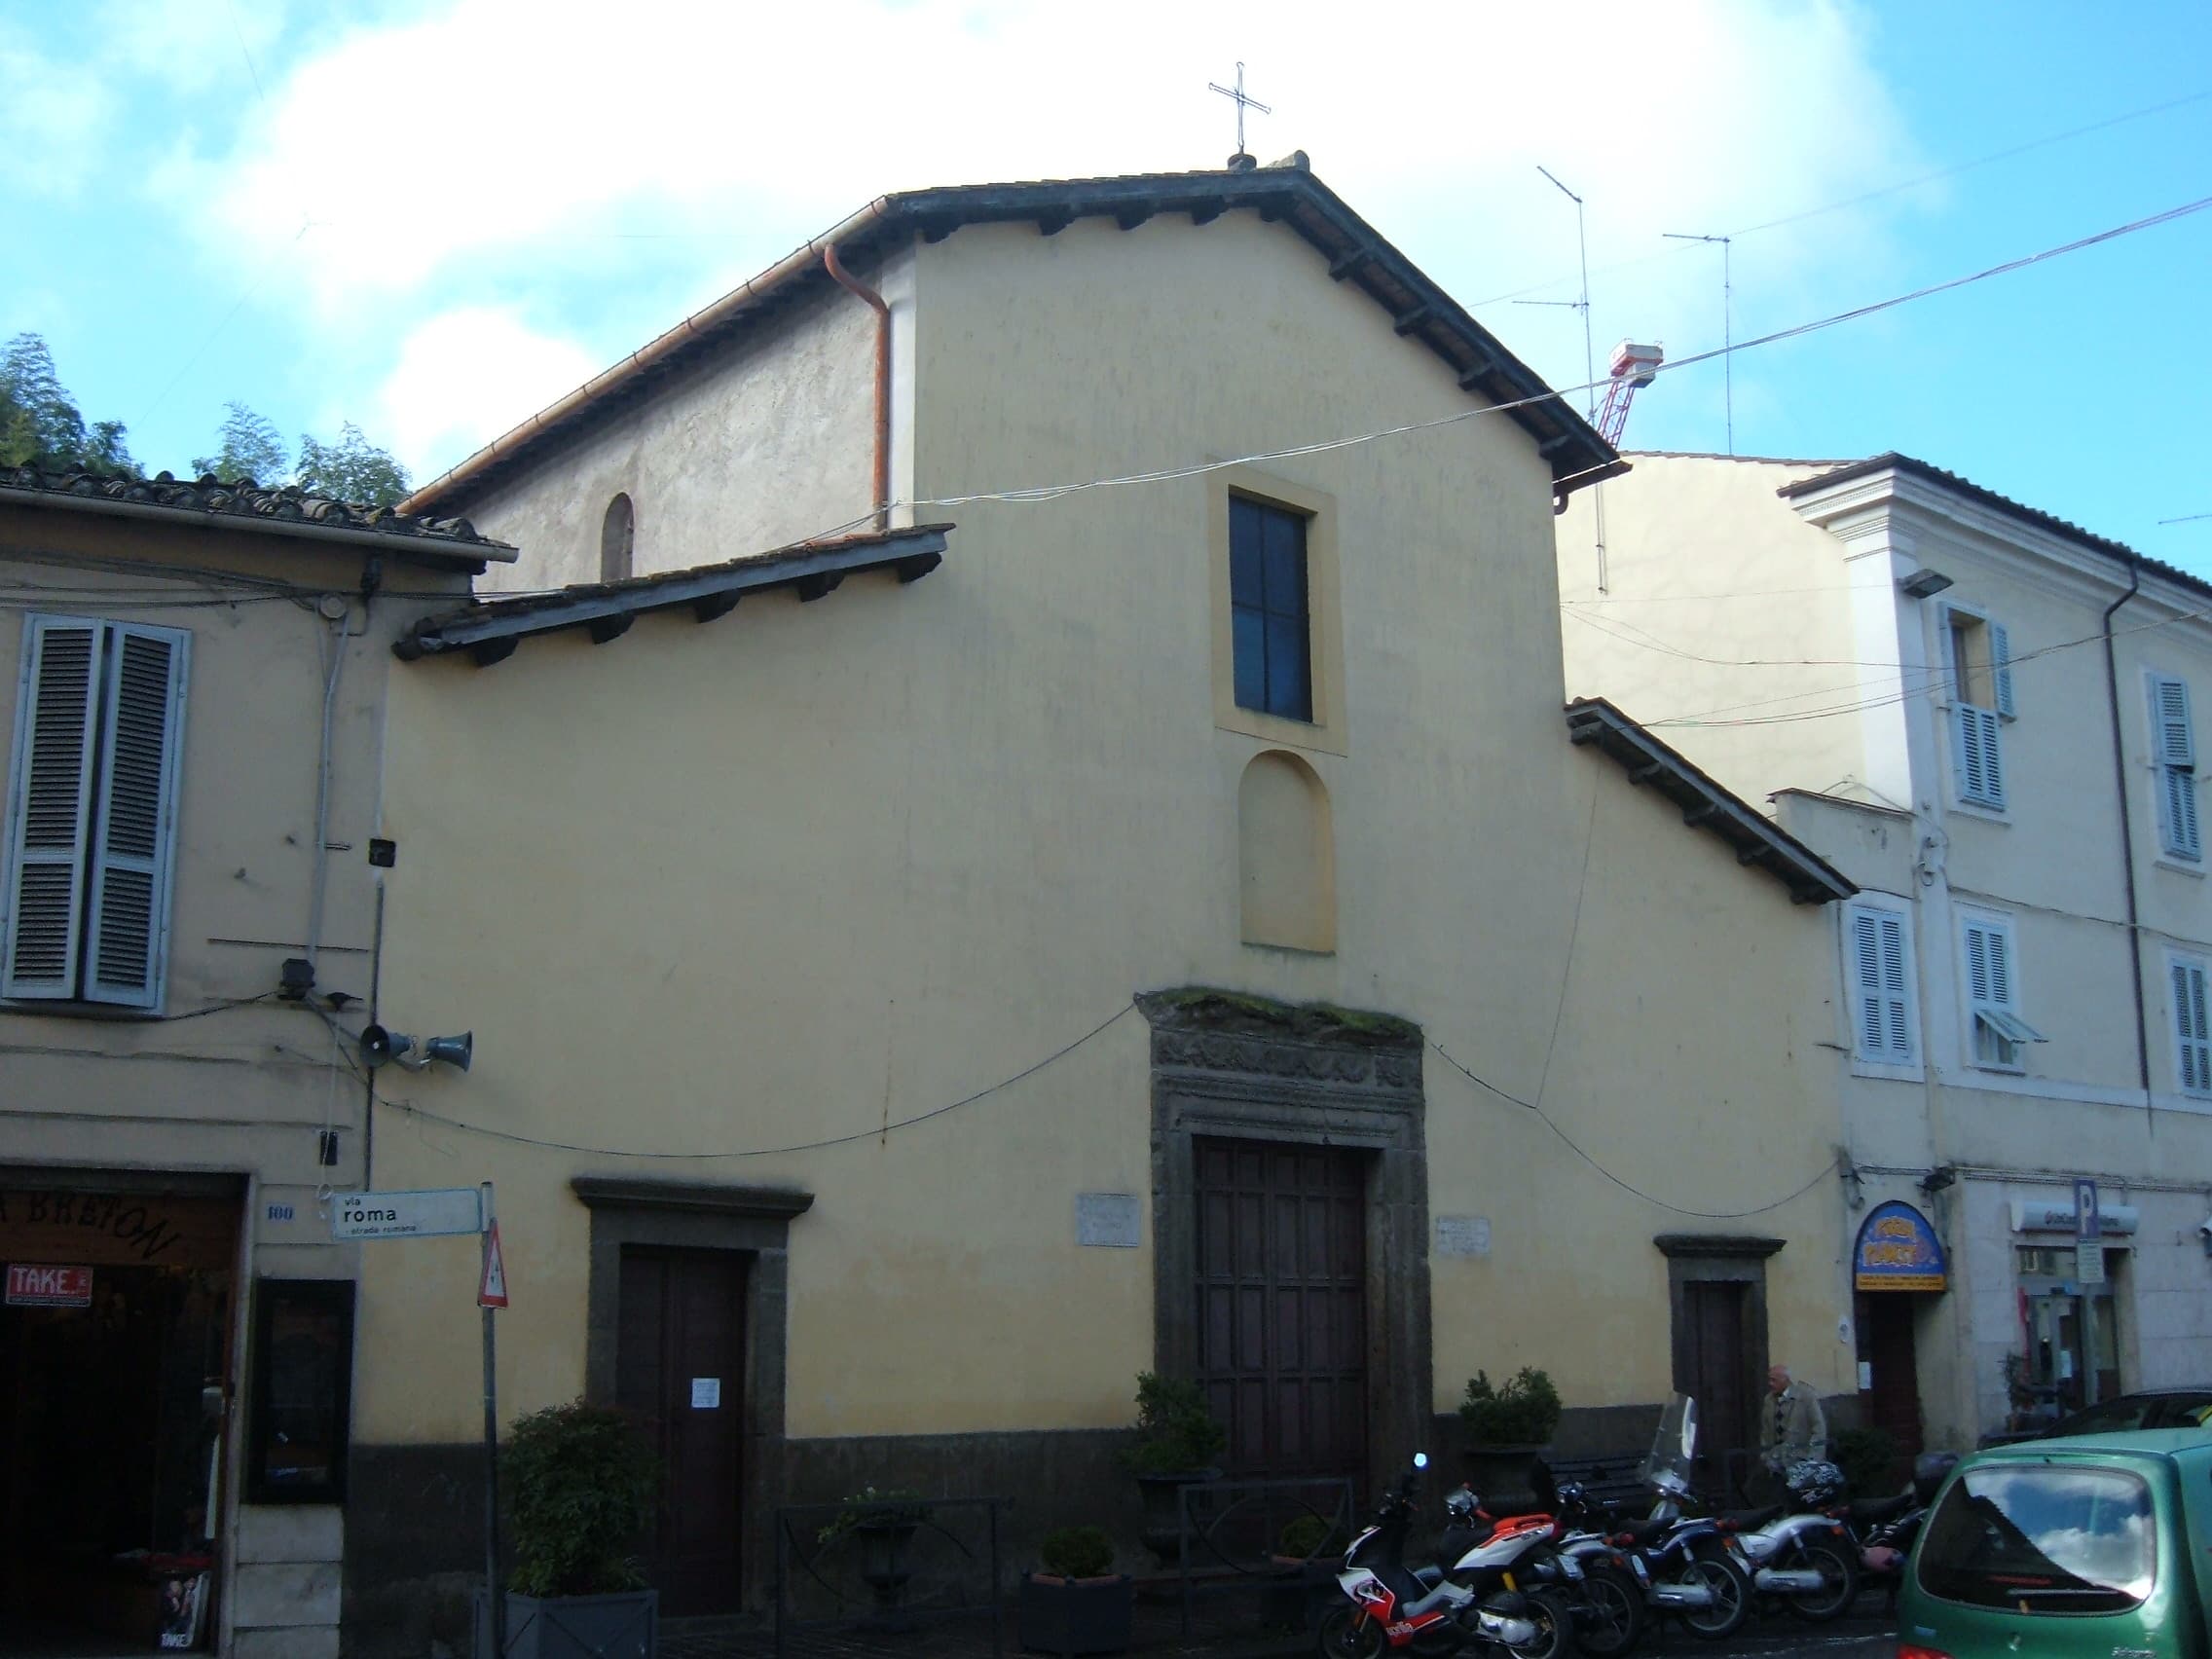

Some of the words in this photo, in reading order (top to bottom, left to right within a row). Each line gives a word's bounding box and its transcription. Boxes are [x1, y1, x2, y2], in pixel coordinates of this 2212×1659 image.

[344, 1197, 361, 1207] via
[344, 1208, 396, 1223] roma
[2079, 1185, 2094, 1235] P
